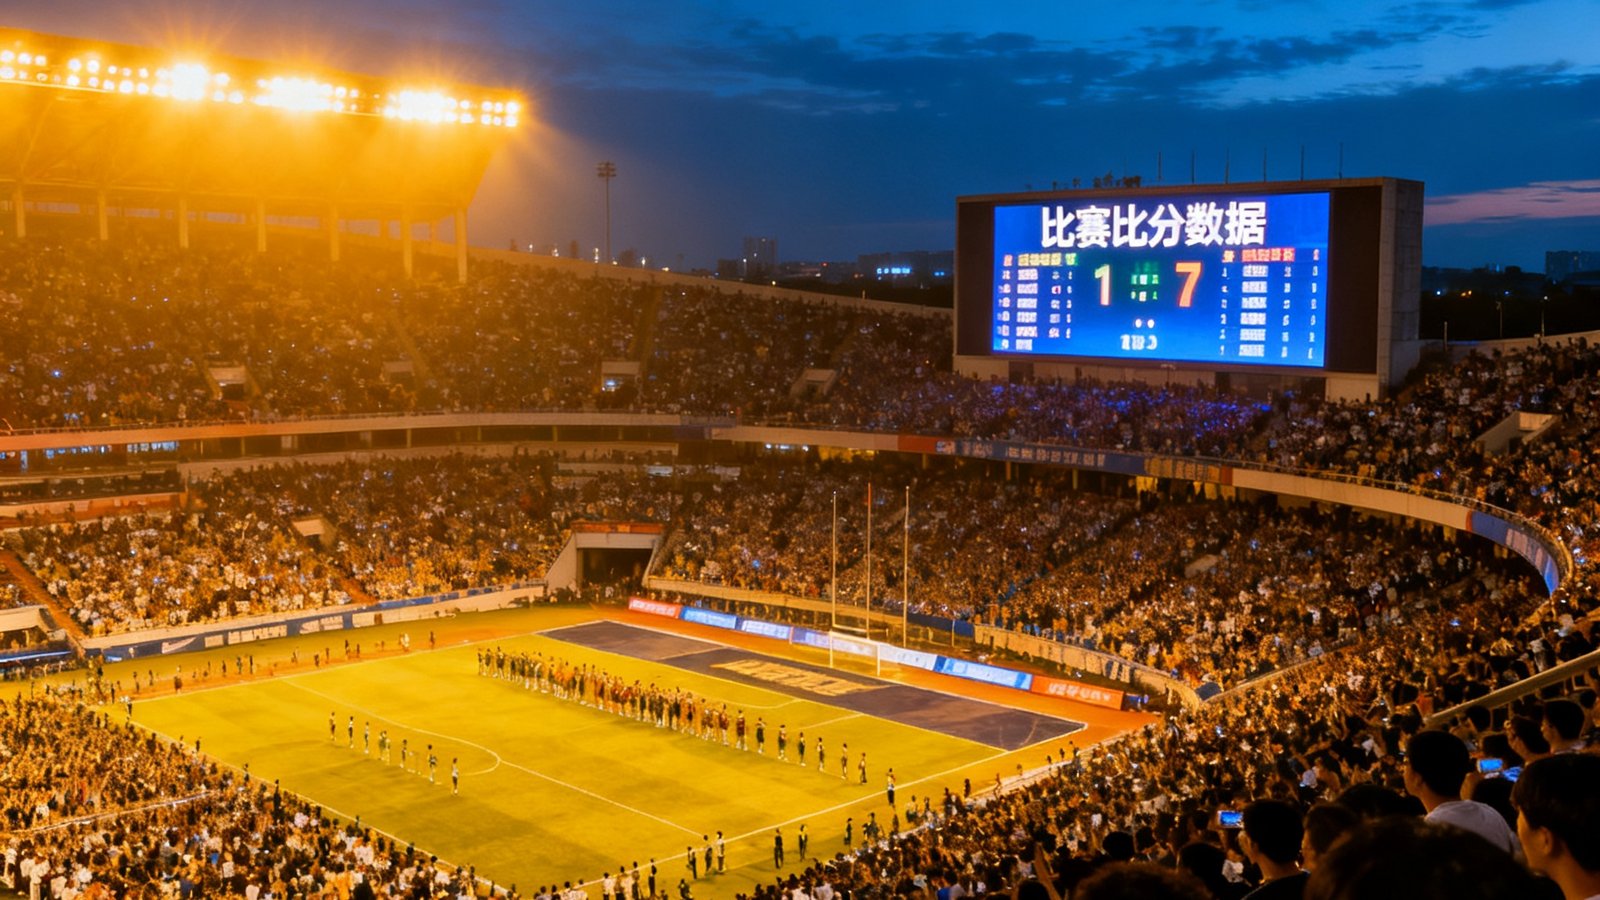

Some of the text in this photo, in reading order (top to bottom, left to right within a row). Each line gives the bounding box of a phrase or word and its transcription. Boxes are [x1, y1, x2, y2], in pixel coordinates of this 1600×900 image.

[1041, 201, 1267, 248] 比赛比分数据
[1094, 264, 1111, 306] 1
[1175, 261, 1202, 308] 7
